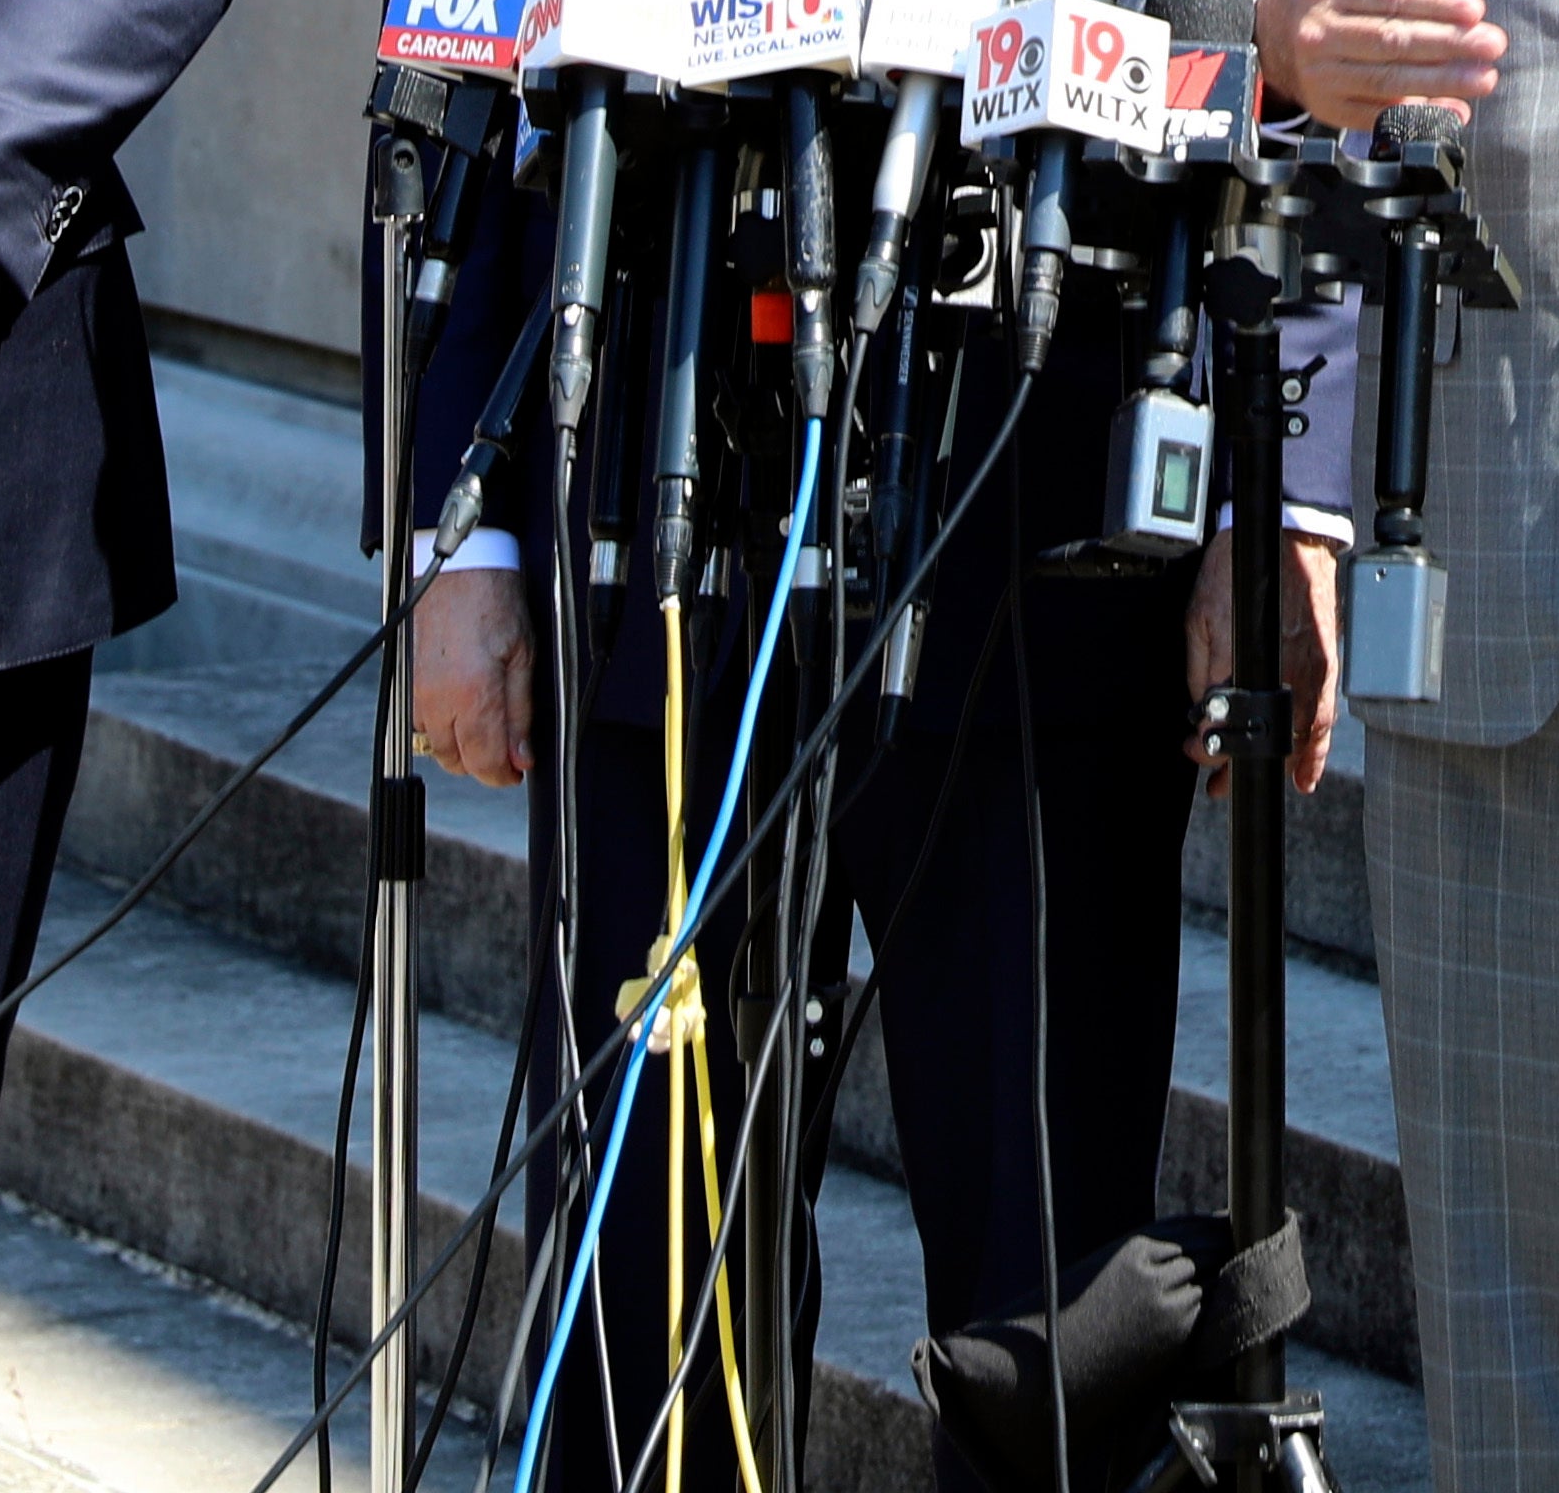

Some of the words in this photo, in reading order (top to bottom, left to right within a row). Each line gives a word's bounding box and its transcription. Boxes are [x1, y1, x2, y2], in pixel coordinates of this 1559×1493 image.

[397, 33, 495, 64] CAROLINA
[693, 19, 762, 48] NEWS
[976, 17, 1023, 91] 19
[1068, 14, 1125, 83] 19
[972, 79, 1042, 127] WLTX
[1065, 82, 1149, 131] WLTX
[1166, 108, 1233, 139] TOC
